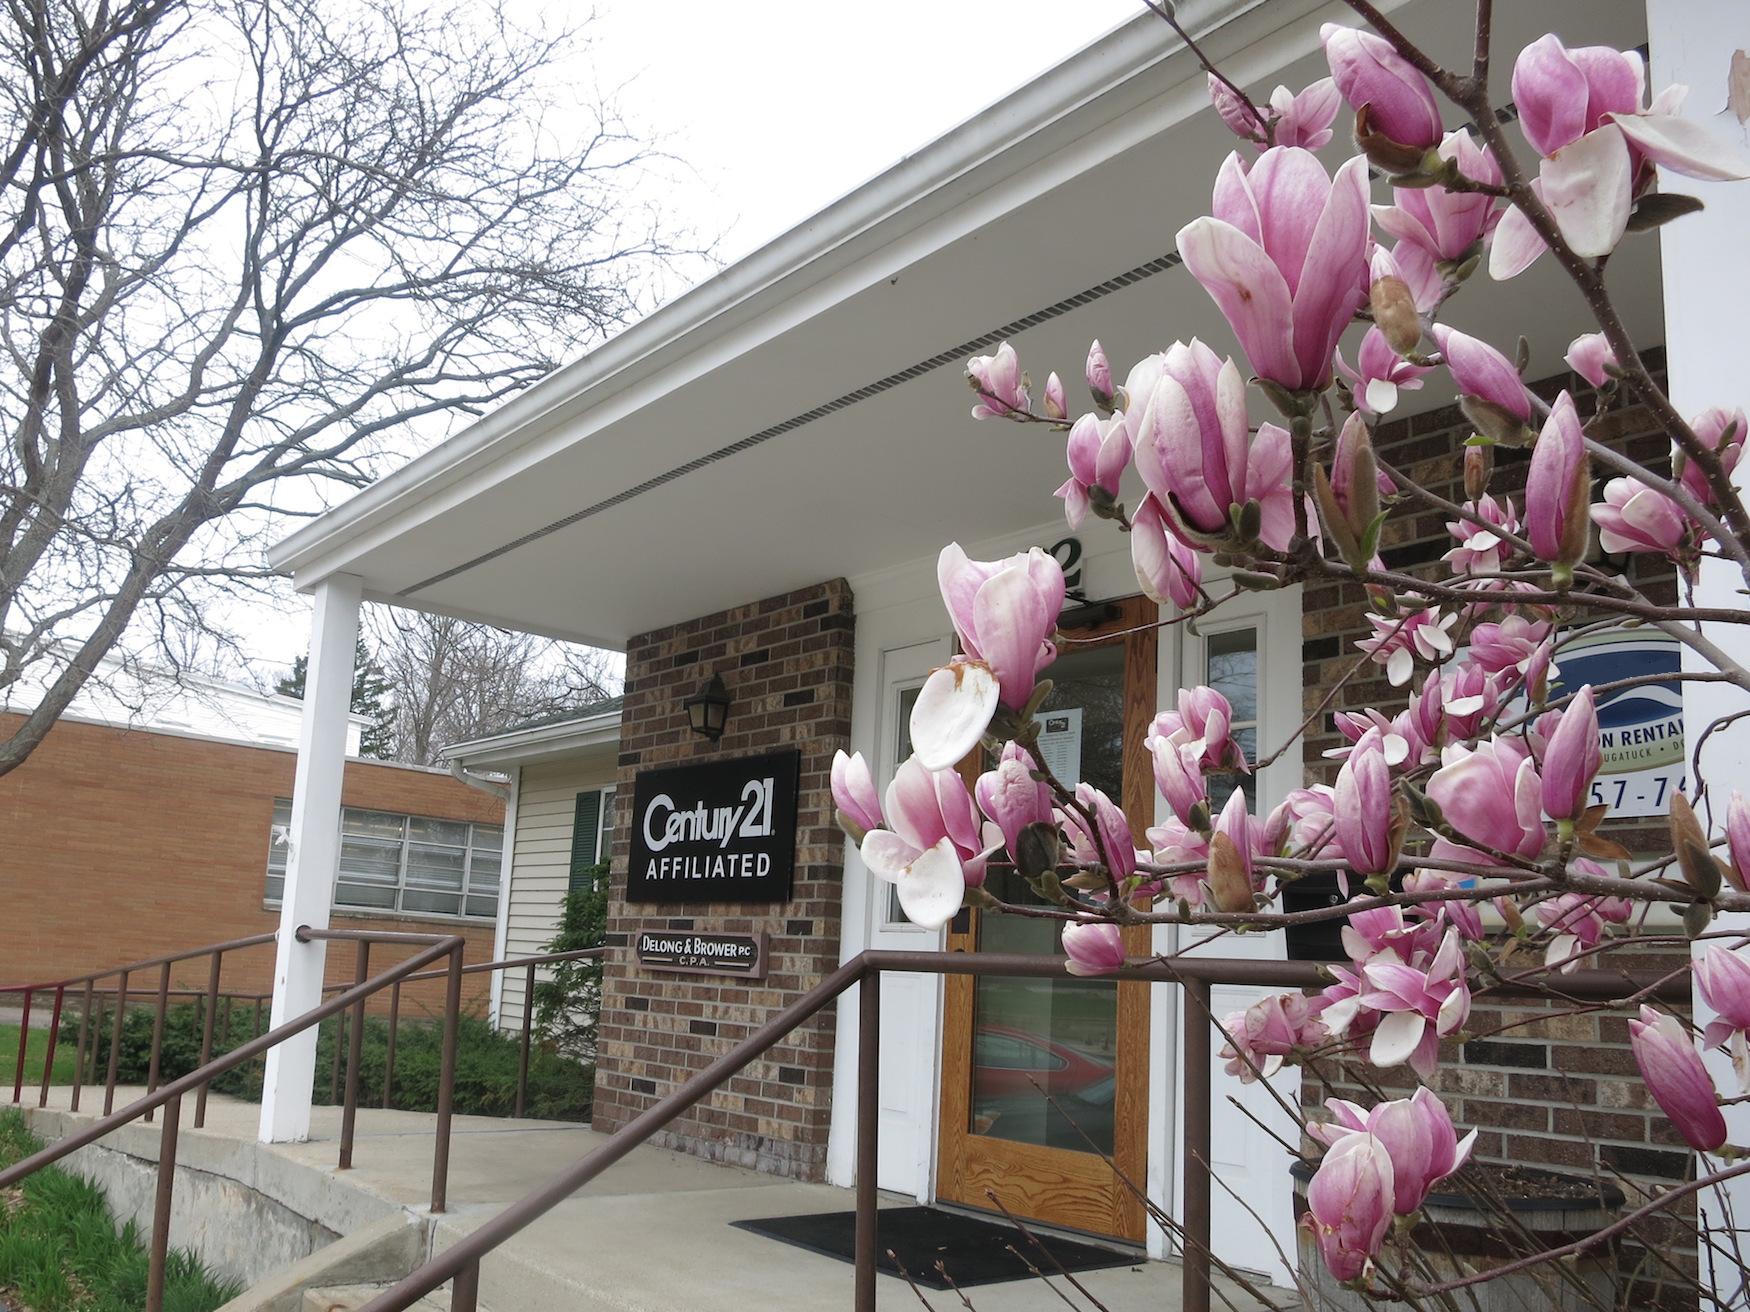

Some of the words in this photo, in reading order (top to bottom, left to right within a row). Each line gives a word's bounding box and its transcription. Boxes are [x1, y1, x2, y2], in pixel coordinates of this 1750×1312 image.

[1598, 732, 1613, 748] N
[1603, 747, 1652, 762] UGATUCK
[643, 794, 746, 852] Century
[739, 777, 775, 838] 21
[646, 852, 771, 880] AFFILIATED
[684, 938, 692, 955] &
[693, 937, 737, 957] BROWER
[679, 955, 710, 967] C.P.A.
